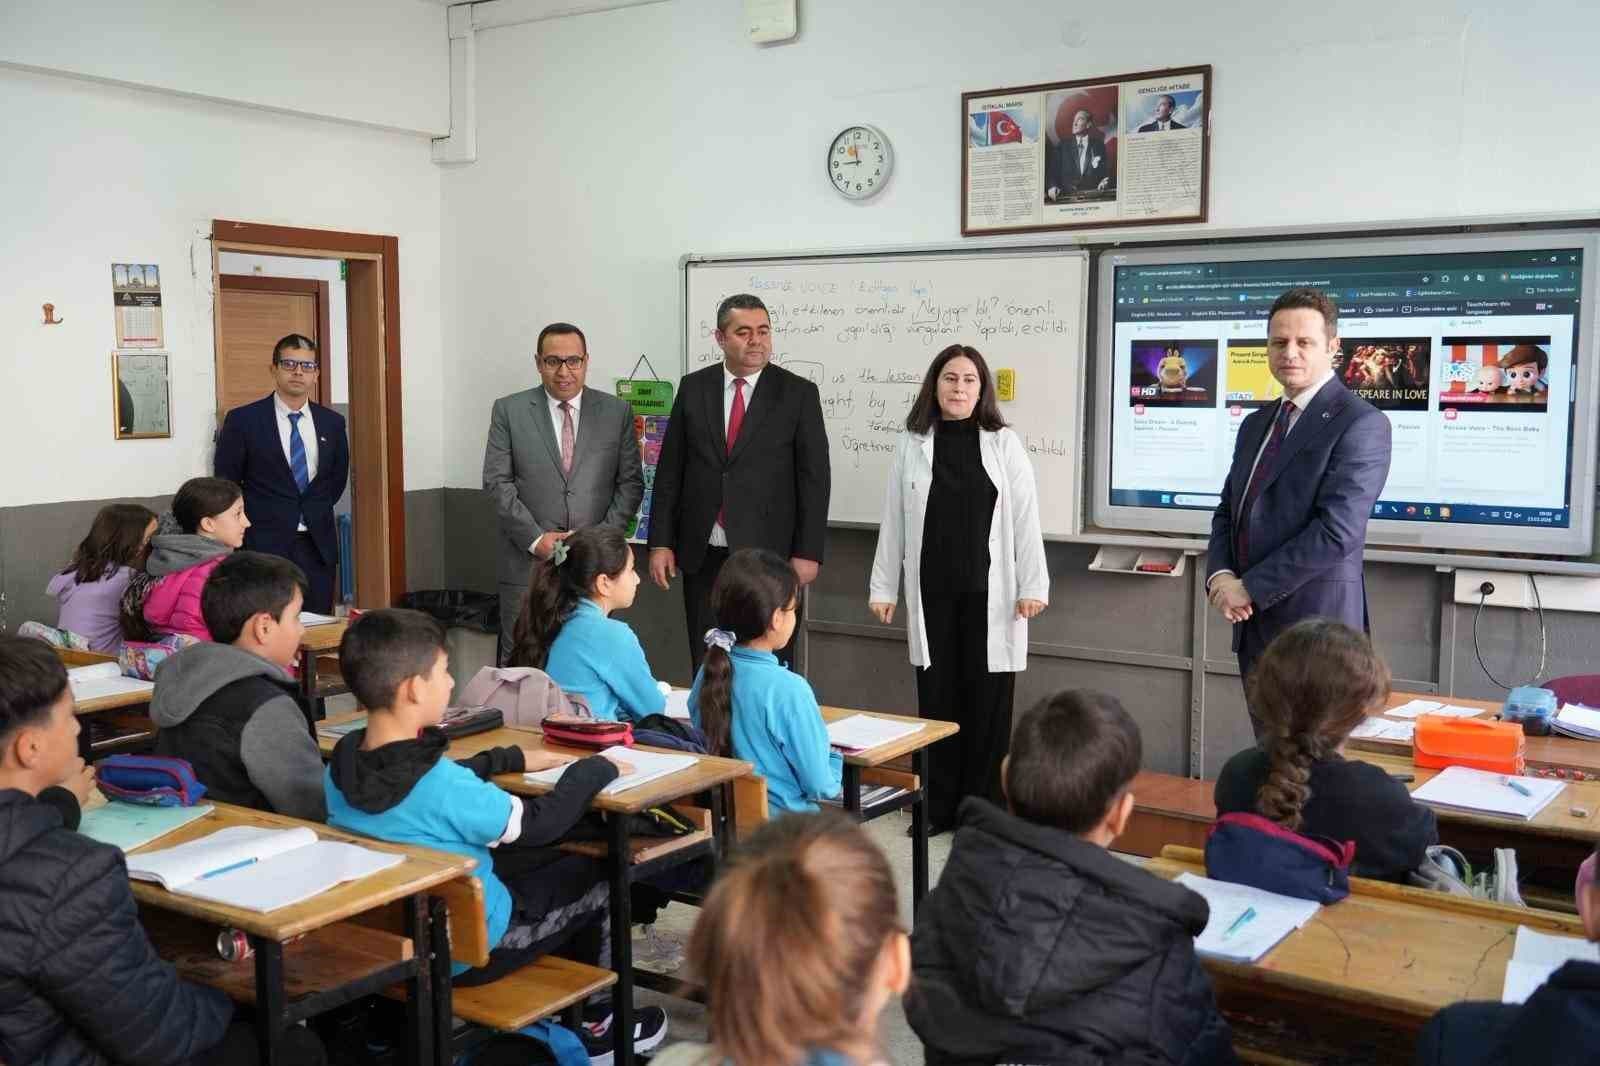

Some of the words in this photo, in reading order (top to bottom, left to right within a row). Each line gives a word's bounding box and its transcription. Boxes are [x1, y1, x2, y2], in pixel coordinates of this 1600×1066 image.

[1141, 387, 1157, 397] HD
[1392, 388, 1403, 400] IN
[1404, 388, 1428, 400] LOVE
